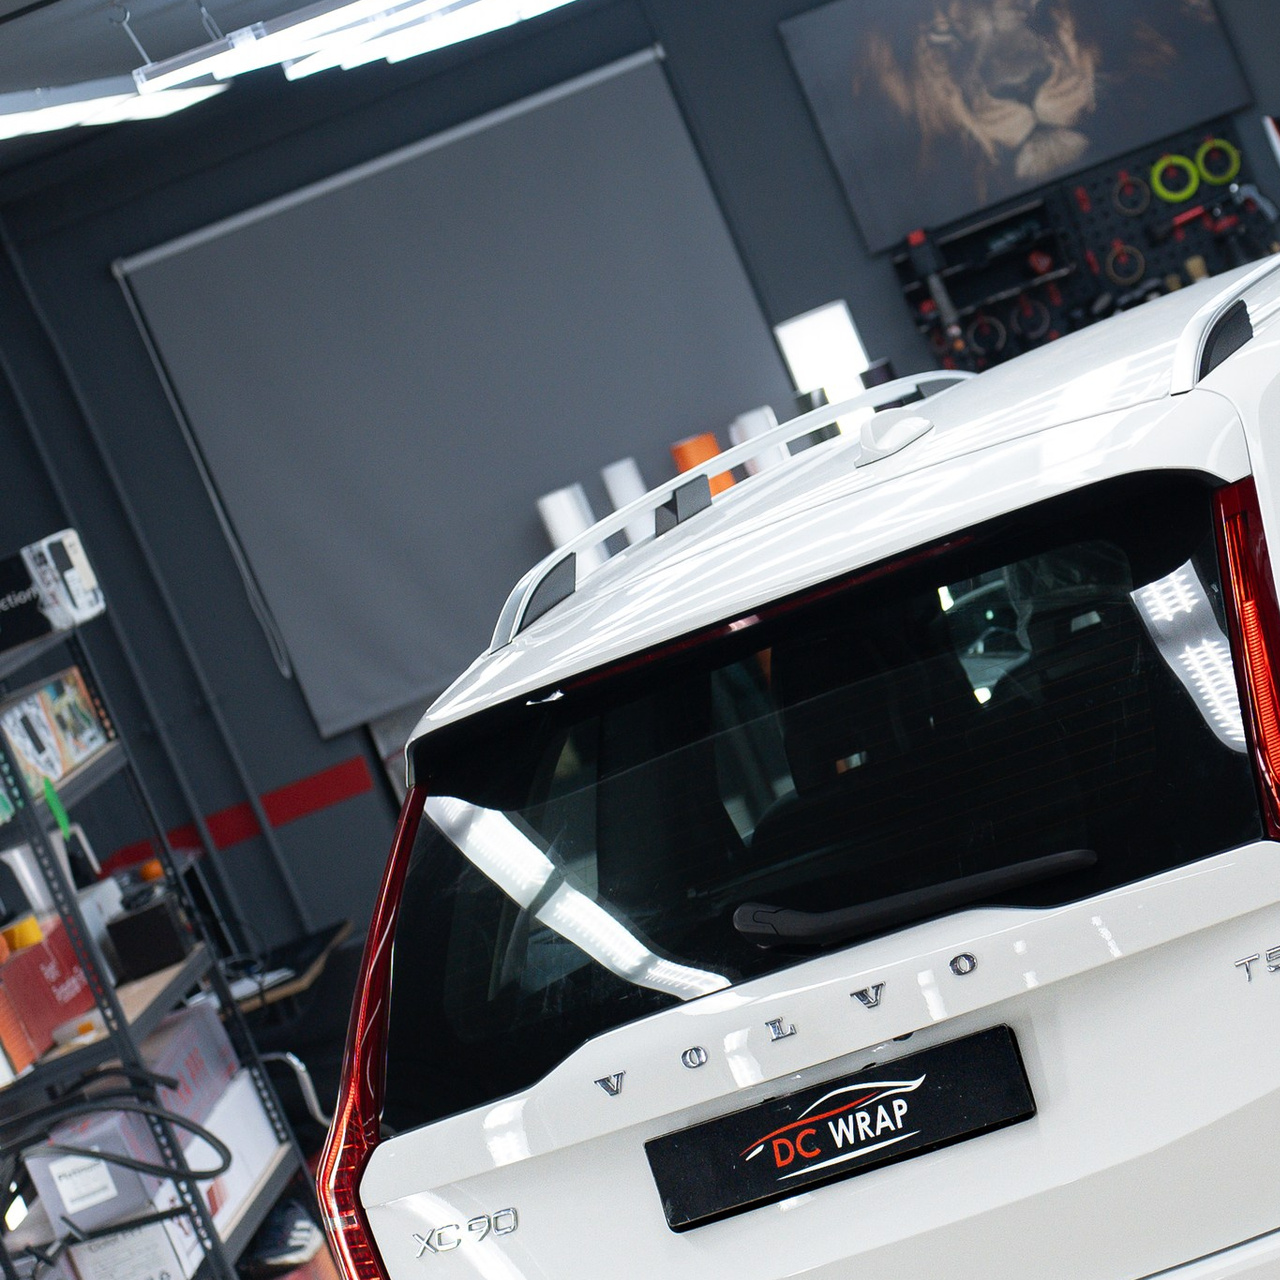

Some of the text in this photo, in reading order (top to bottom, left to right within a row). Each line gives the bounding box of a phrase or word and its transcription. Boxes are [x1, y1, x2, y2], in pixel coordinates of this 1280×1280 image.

[594, 952, 978, 1097] VOLVO
[772, 1099, 908, 1168] DC WRAP
